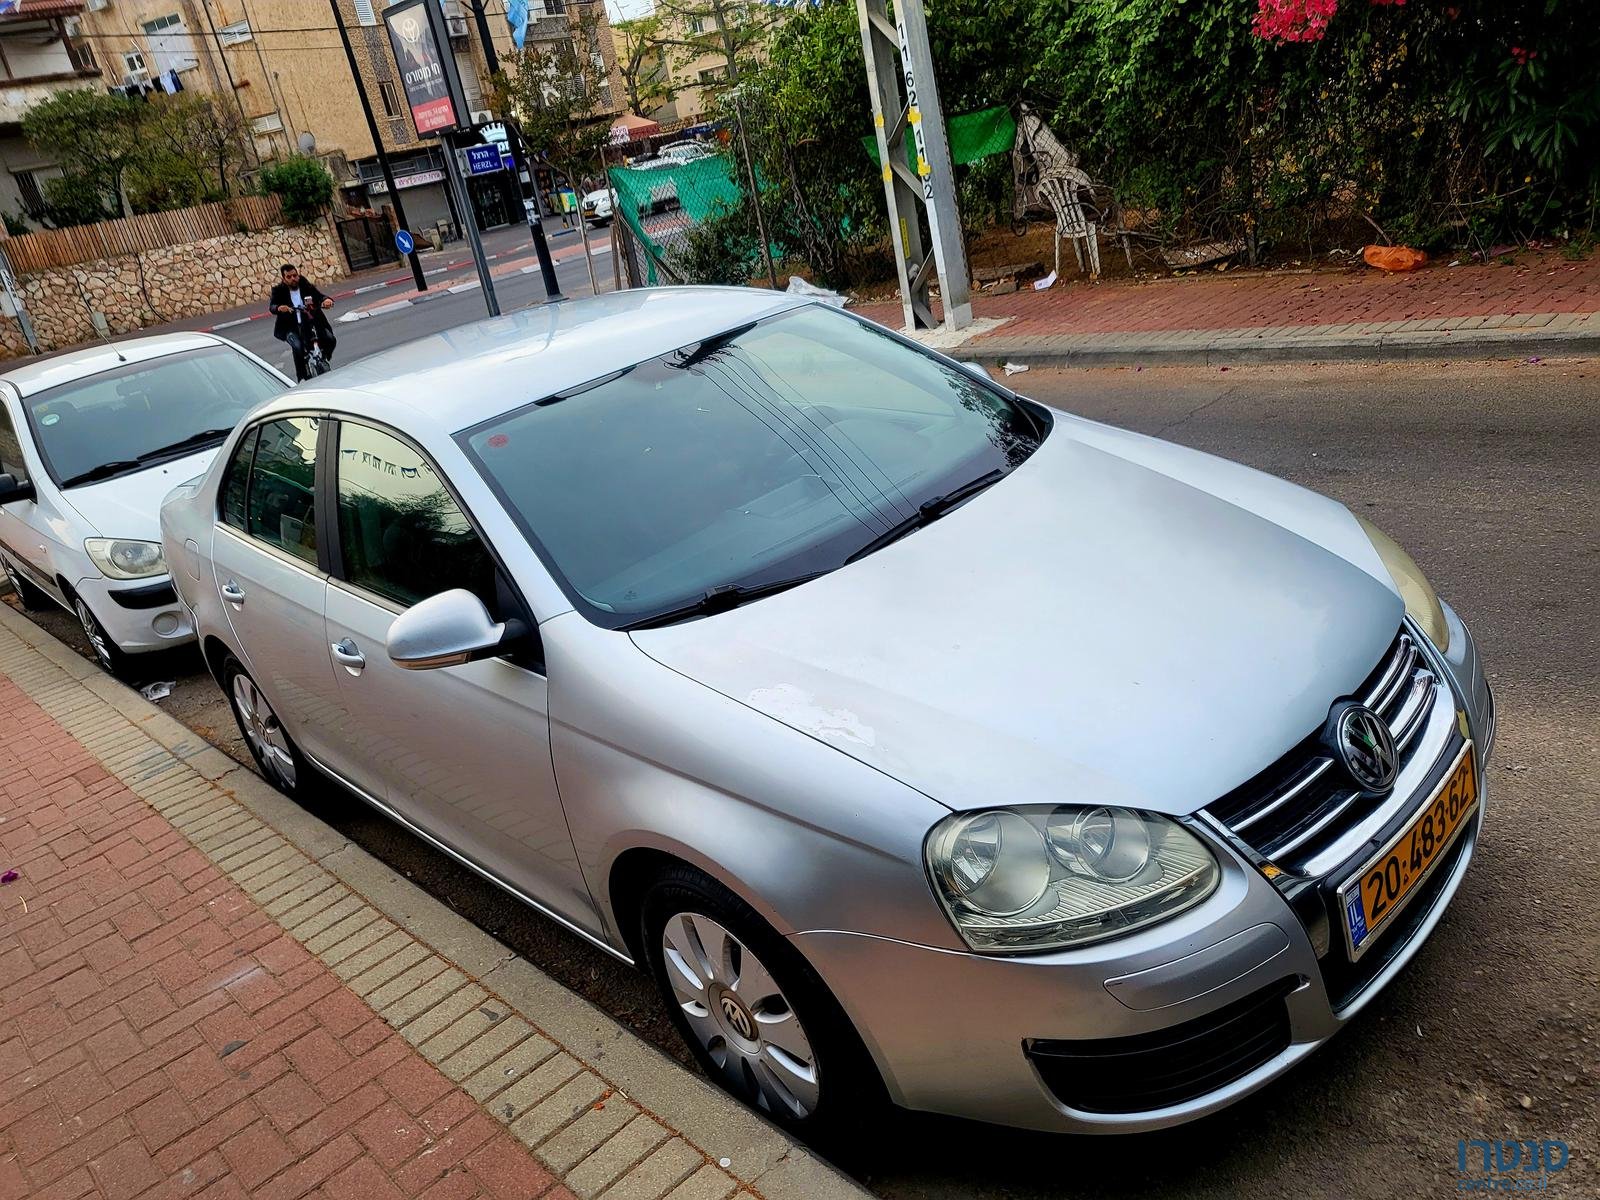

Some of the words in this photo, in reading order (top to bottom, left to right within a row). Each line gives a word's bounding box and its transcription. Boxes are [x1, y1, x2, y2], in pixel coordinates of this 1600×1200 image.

[431, 62, 440, 75] חי
[405, 67, 431, 84] מוטורס
[471, 150, 489, 160] הרצל
[473, 161, 493, 171] HERZL
[1350, 902, 1361, 926] IL
